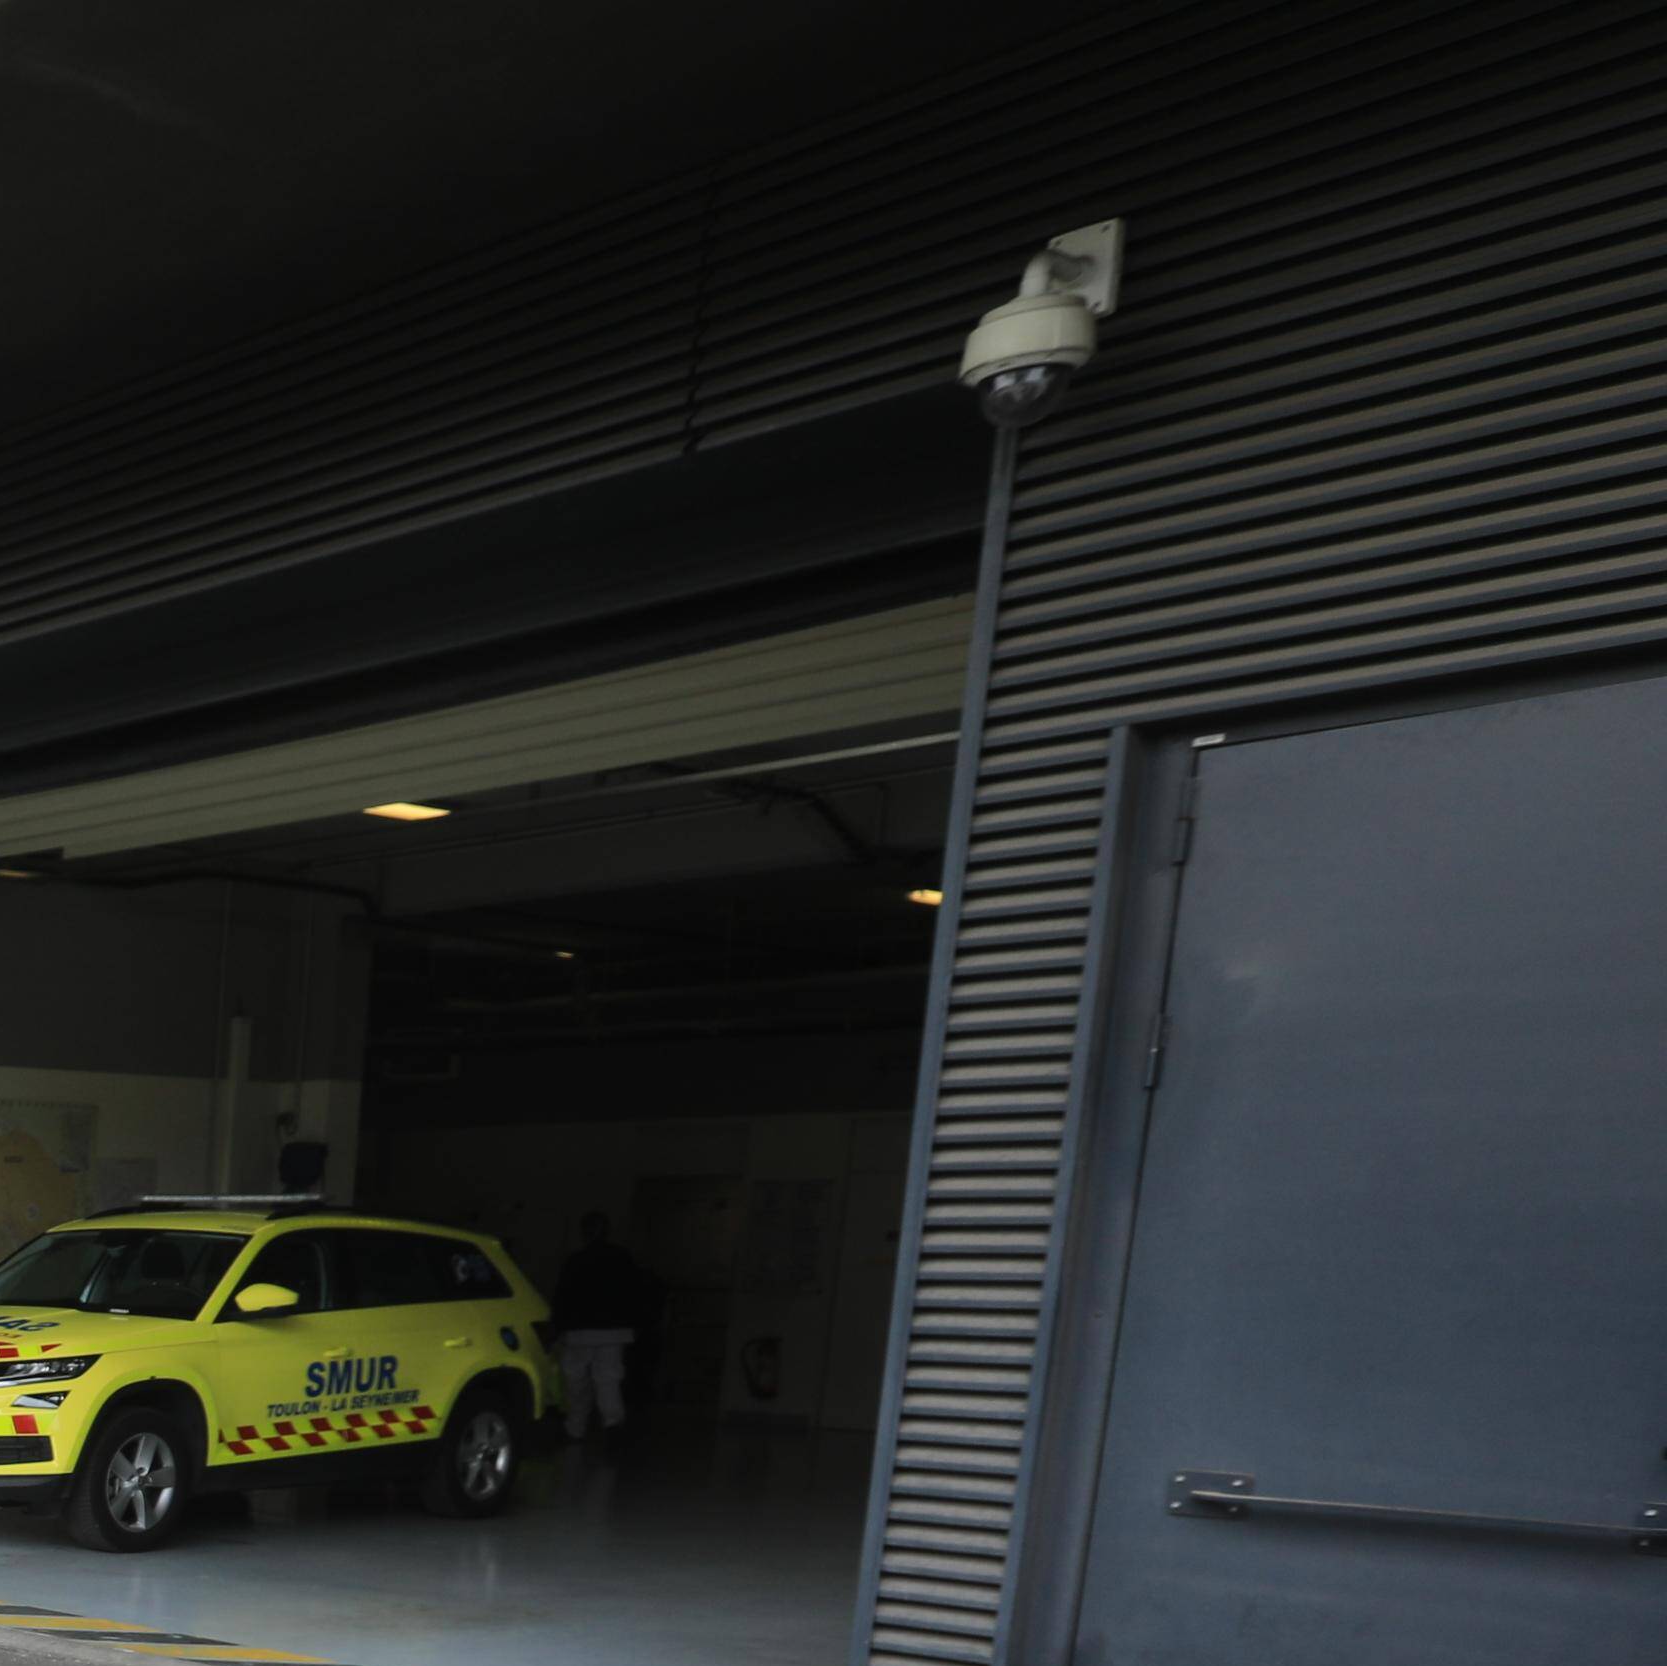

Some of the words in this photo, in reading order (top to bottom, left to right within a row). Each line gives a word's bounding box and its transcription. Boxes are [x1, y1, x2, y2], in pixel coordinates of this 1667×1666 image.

[305, 1355, 399, 1398] SMUR
[267, 1402, 322, 1418] TOULON
[331, 1399, 347, 1412] LA
